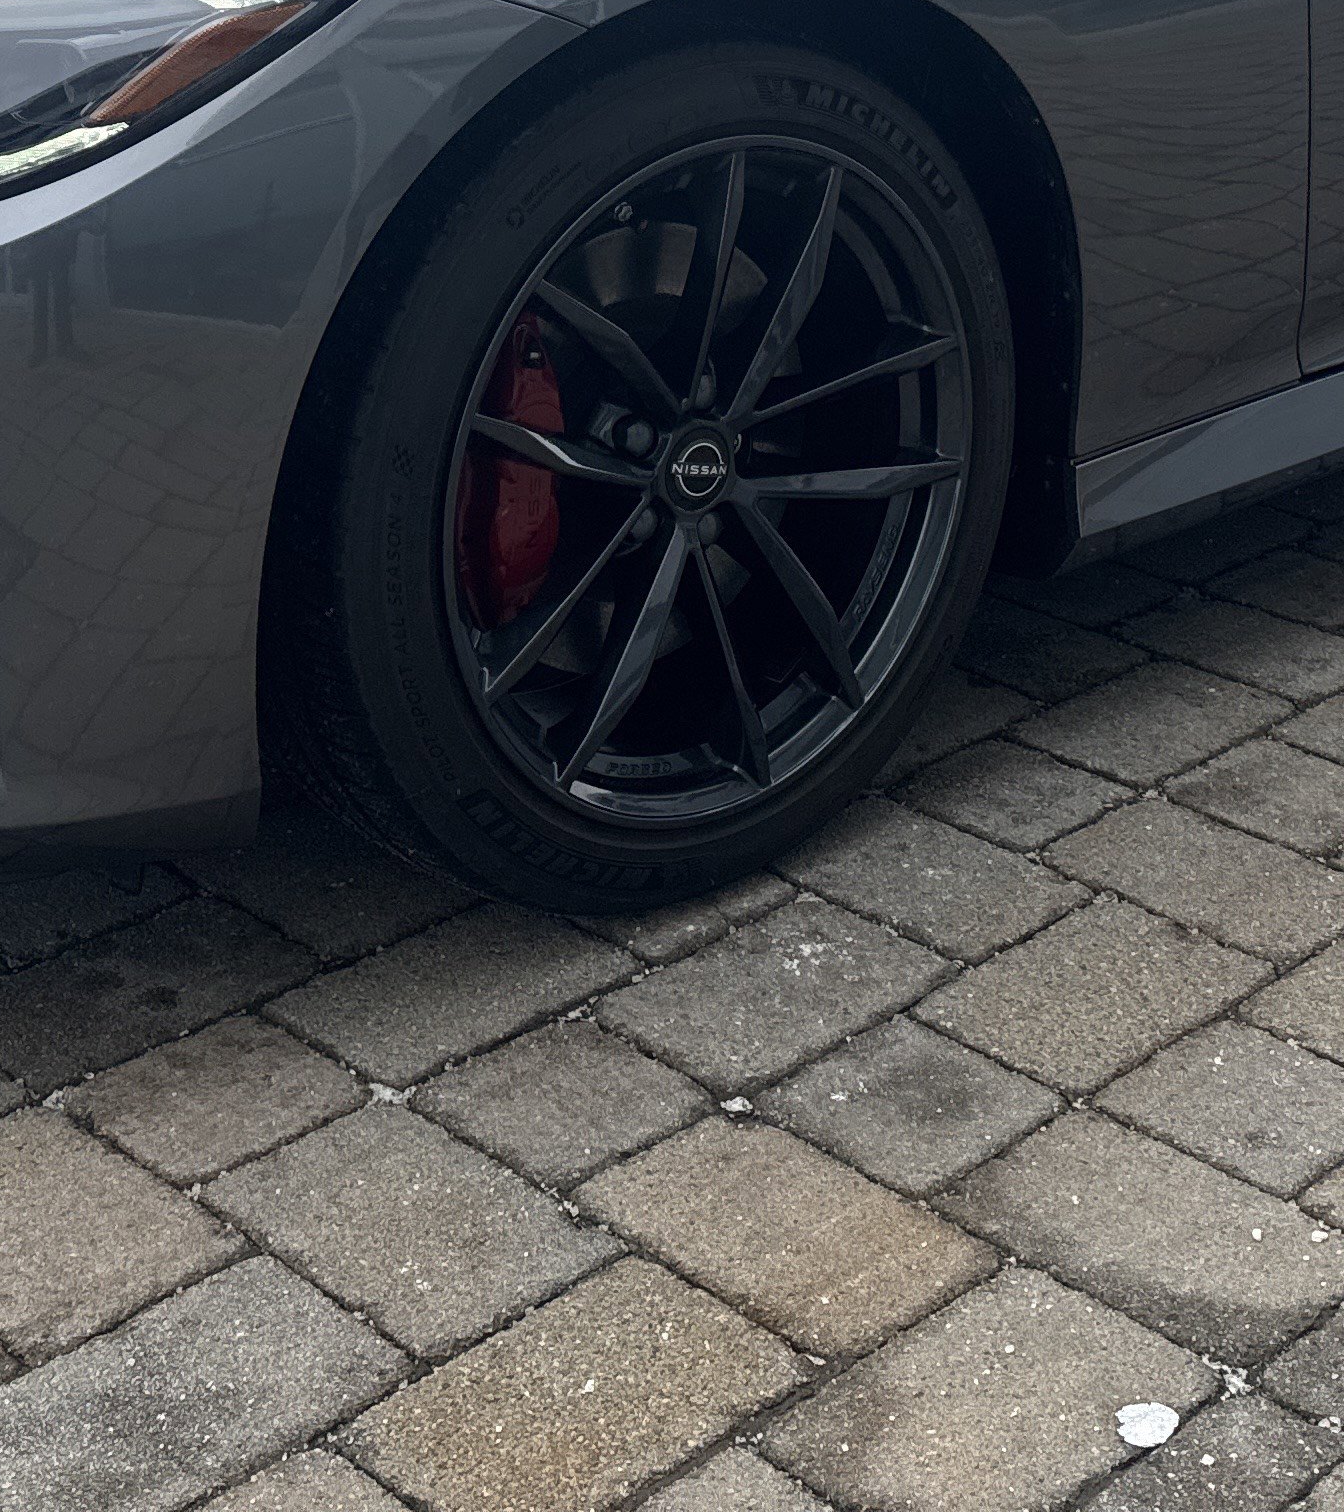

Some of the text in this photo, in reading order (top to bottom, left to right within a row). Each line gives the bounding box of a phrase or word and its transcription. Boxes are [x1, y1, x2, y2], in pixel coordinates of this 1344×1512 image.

[804, 83, 953, 199] MICHELIN
[671, 463, 728, 475] NISSAN
[386, 513, 404, 606] SEASON
